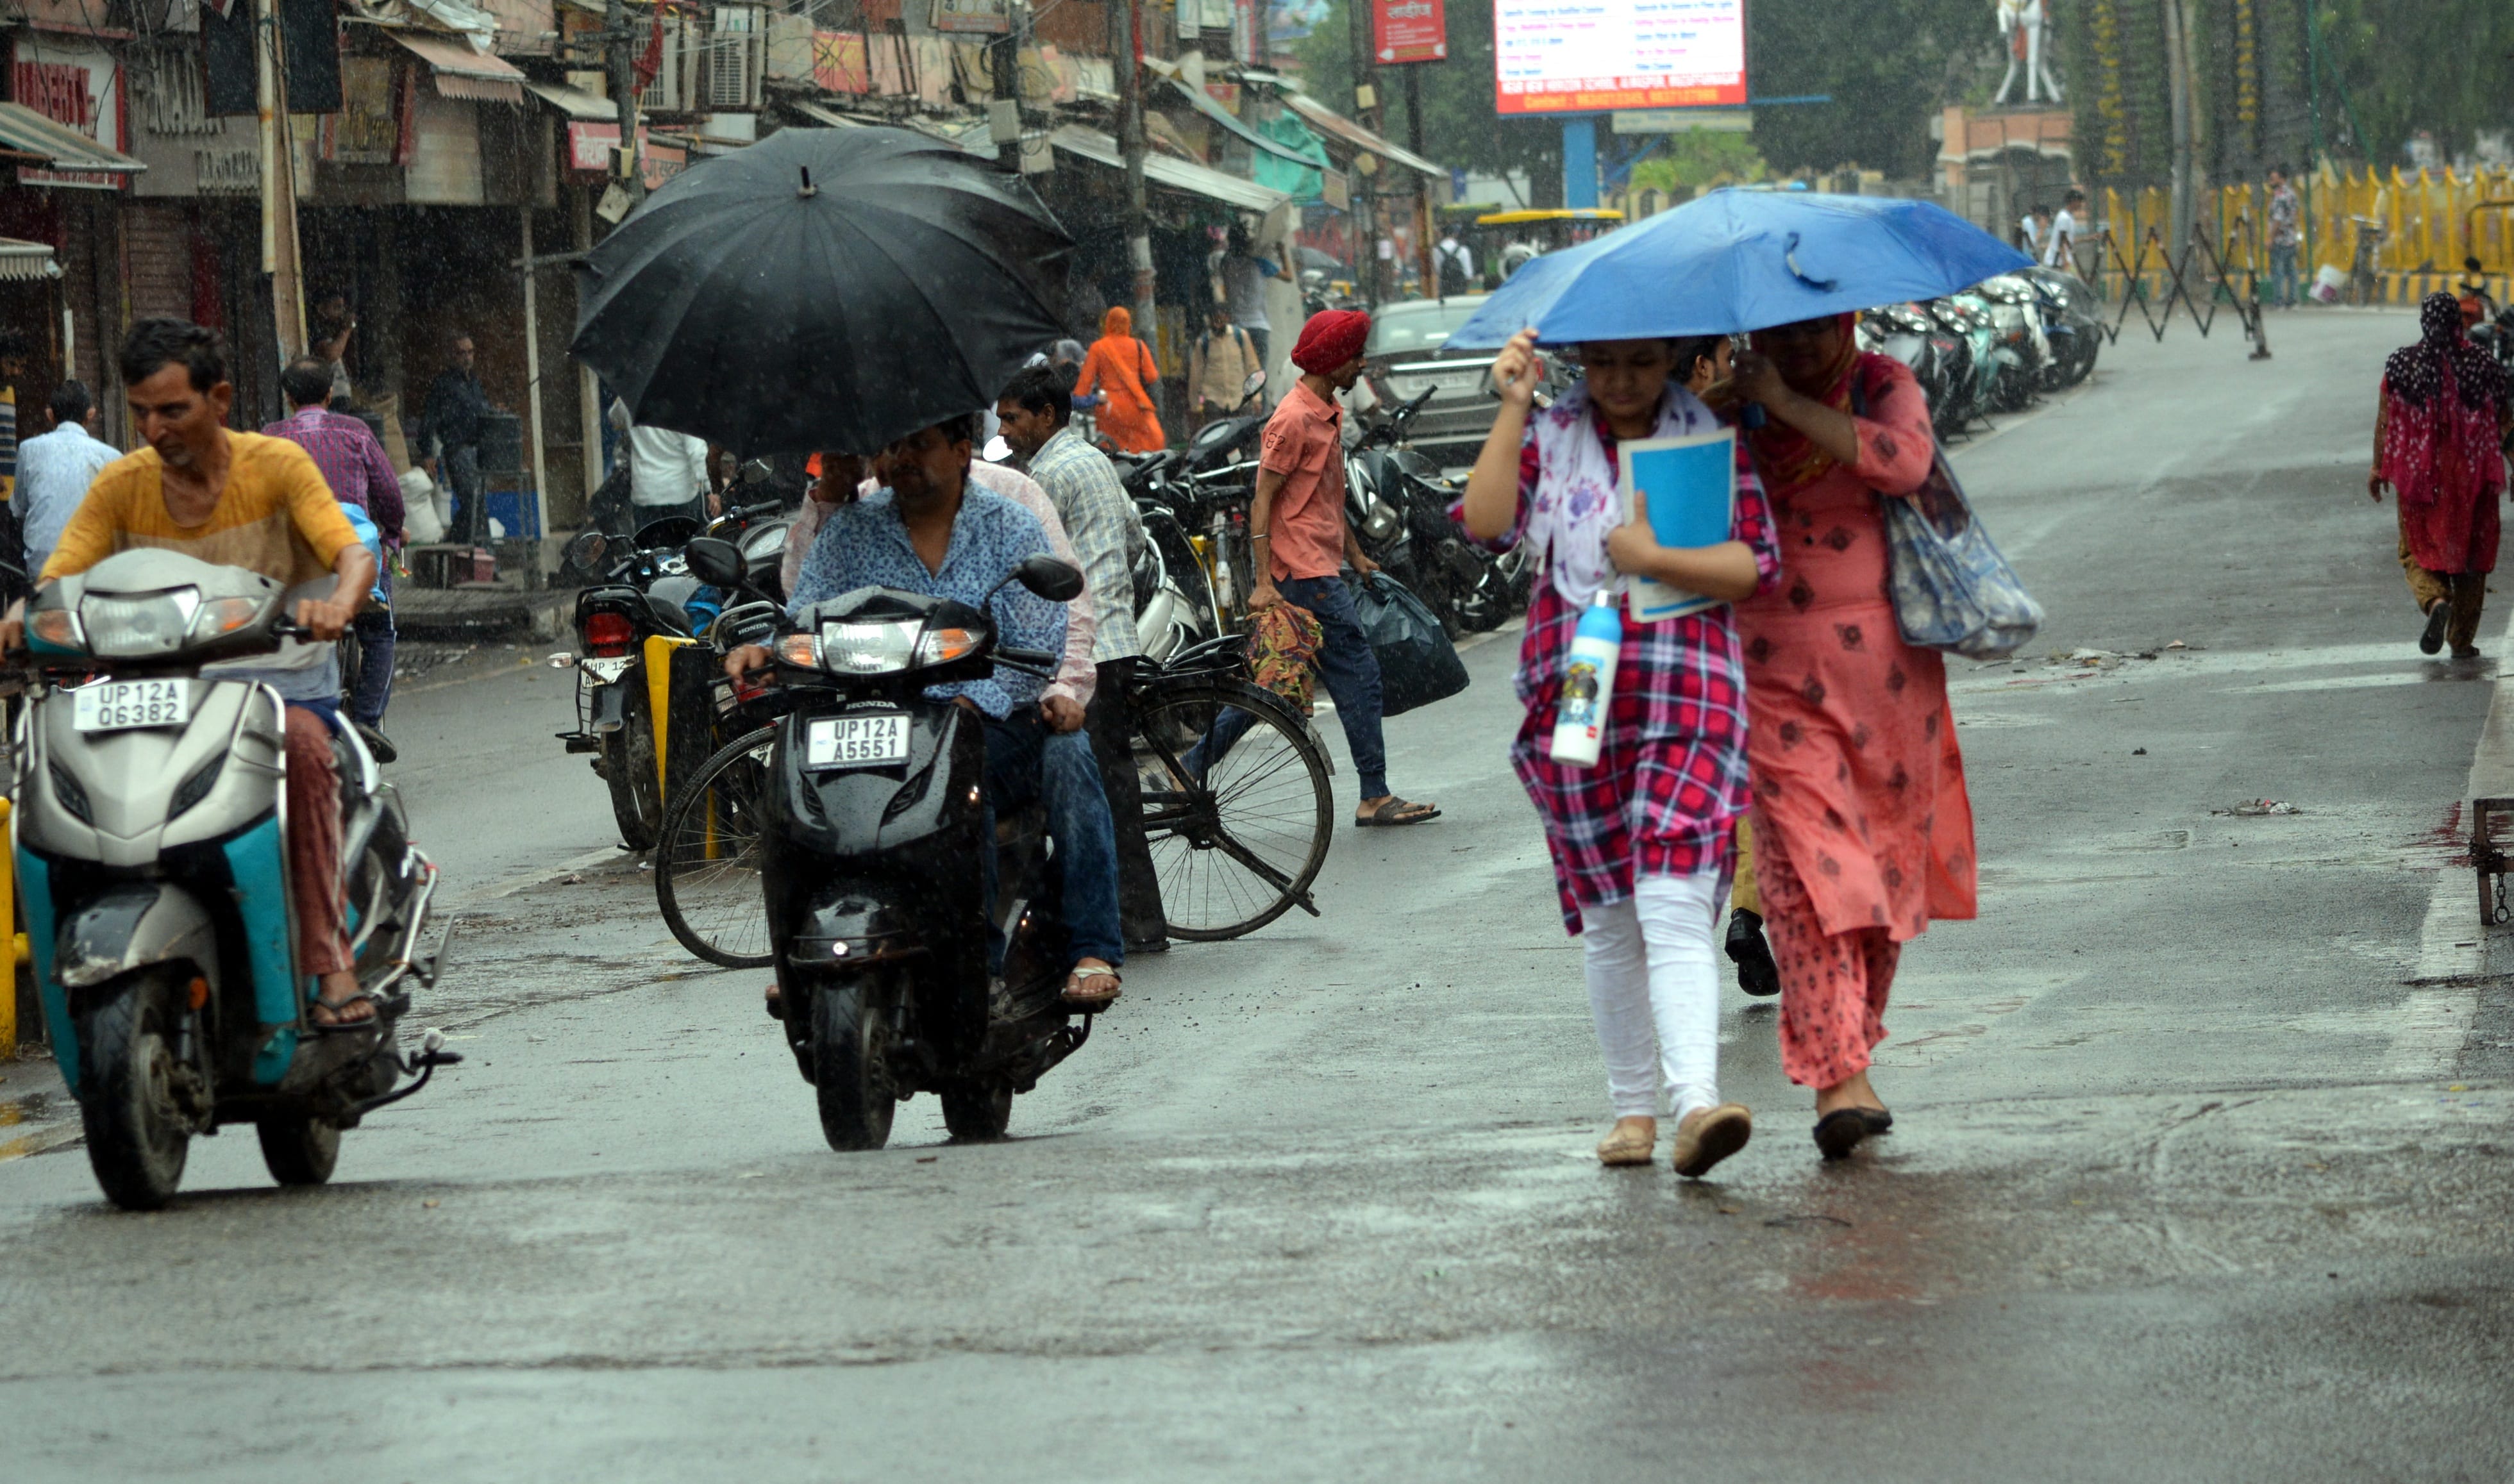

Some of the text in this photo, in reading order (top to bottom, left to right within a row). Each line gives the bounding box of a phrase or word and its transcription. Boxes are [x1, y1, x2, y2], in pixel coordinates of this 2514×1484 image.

[738, 622, 769, 635] HONDA
[99, 682, 178, 704] UP12A
[846, 701, 898, 710] HONDA
[835, 718, 898, 740] UP12A
[834, 738, 896, 760] A5551
